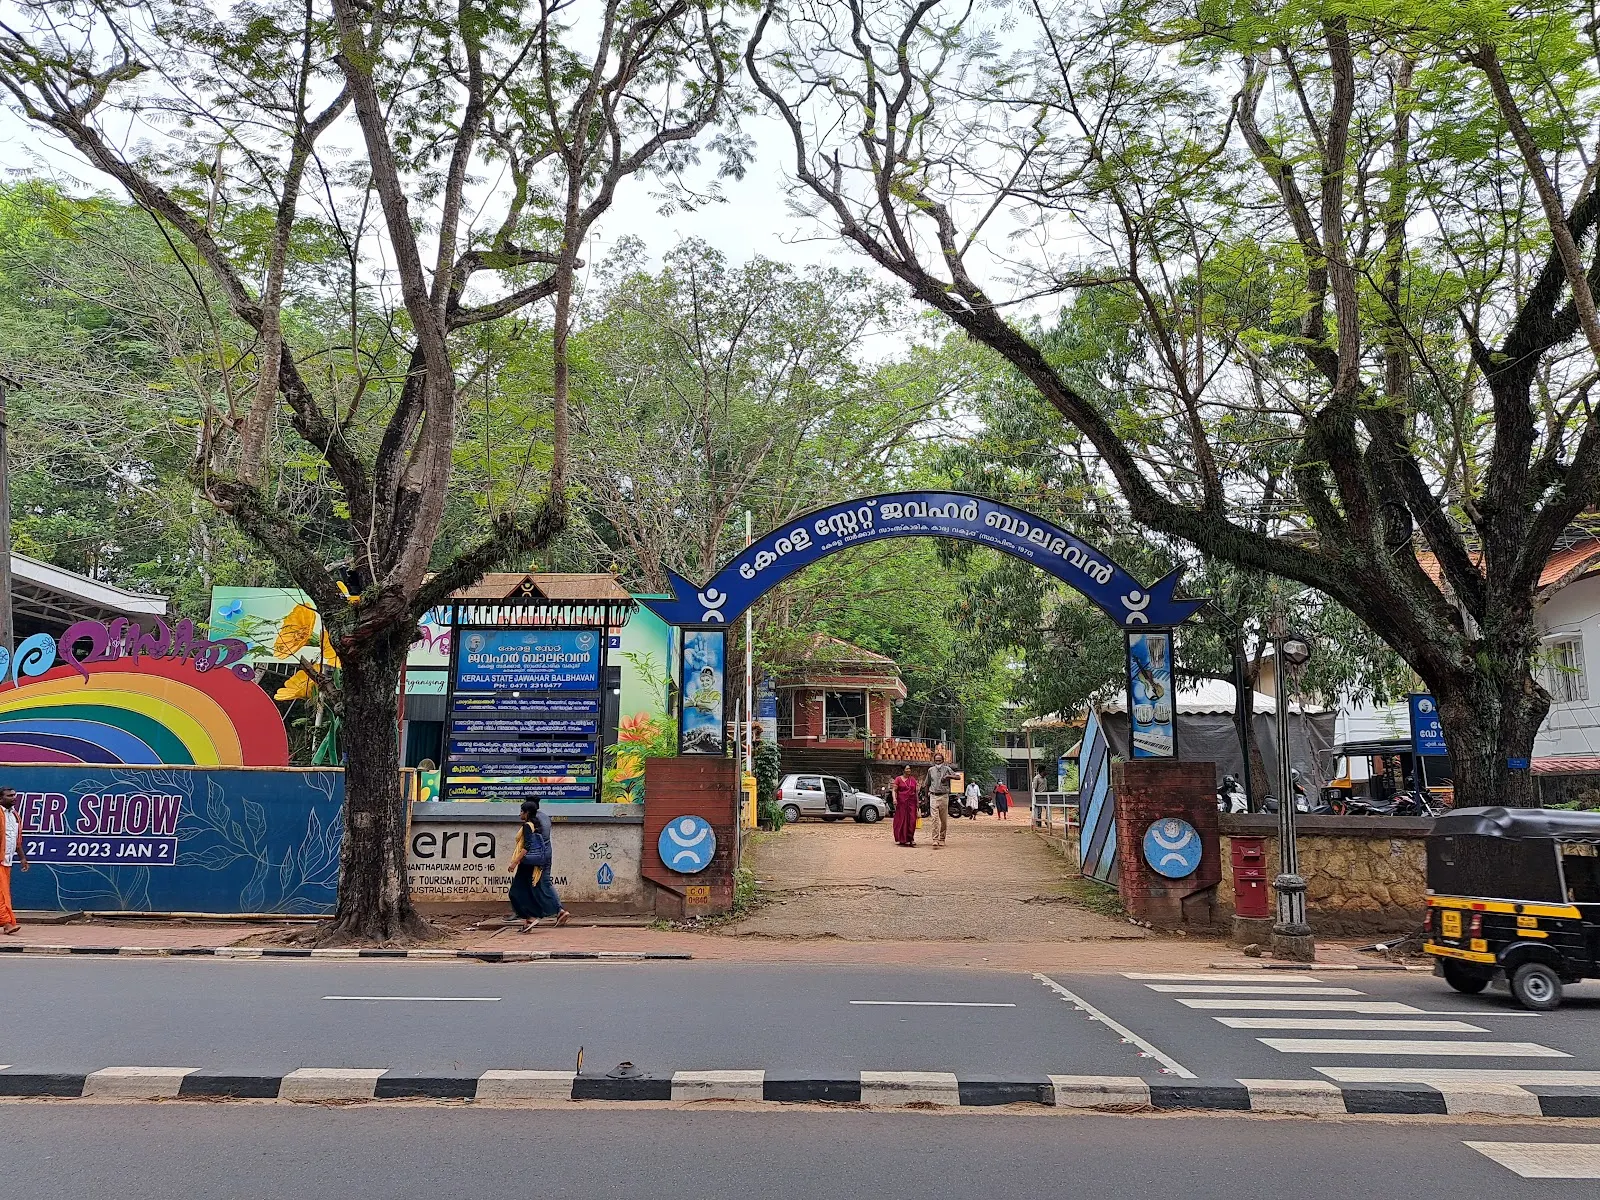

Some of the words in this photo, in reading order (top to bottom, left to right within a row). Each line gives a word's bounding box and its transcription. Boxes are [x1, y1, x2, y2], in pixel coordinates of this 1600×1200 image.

[740, 527, 813, 580] കേരള
[814, 499, 878, 538] സ്റ്റേറ്റ്
[880, 500, 979, 522] ജവഹർ
[985, 510, 1115, 586] ബാലഭവൻ
[821, 539, 843, 551] കേരള
[844, 528, 876, 543] സർക്കാർ
[611, 638, 617, 646] 2
[467, 652, 520, 664] ജവഹർ
[521, 651, 590, 664] ബാലഭവൻ
[461, 675, 491, 683] KERALA
[491, 675, 514, 683] STATE
[513, 674, 550, 683] JAWAHAR
[551, 674, 595, 682] BALBHAVAN
[76, 793, 183, 836] SHOW
[26, 841, 45, 856] 21
[66, 842, 111, 857] 2023
[115, 843, 152, 858] JAN
[157, 843, 169, 858] 2
[419, 875, 454, 885] TOURISM
[461, 876, 480, 885] DTPC
[453, 886, 489, 894] KERALA
